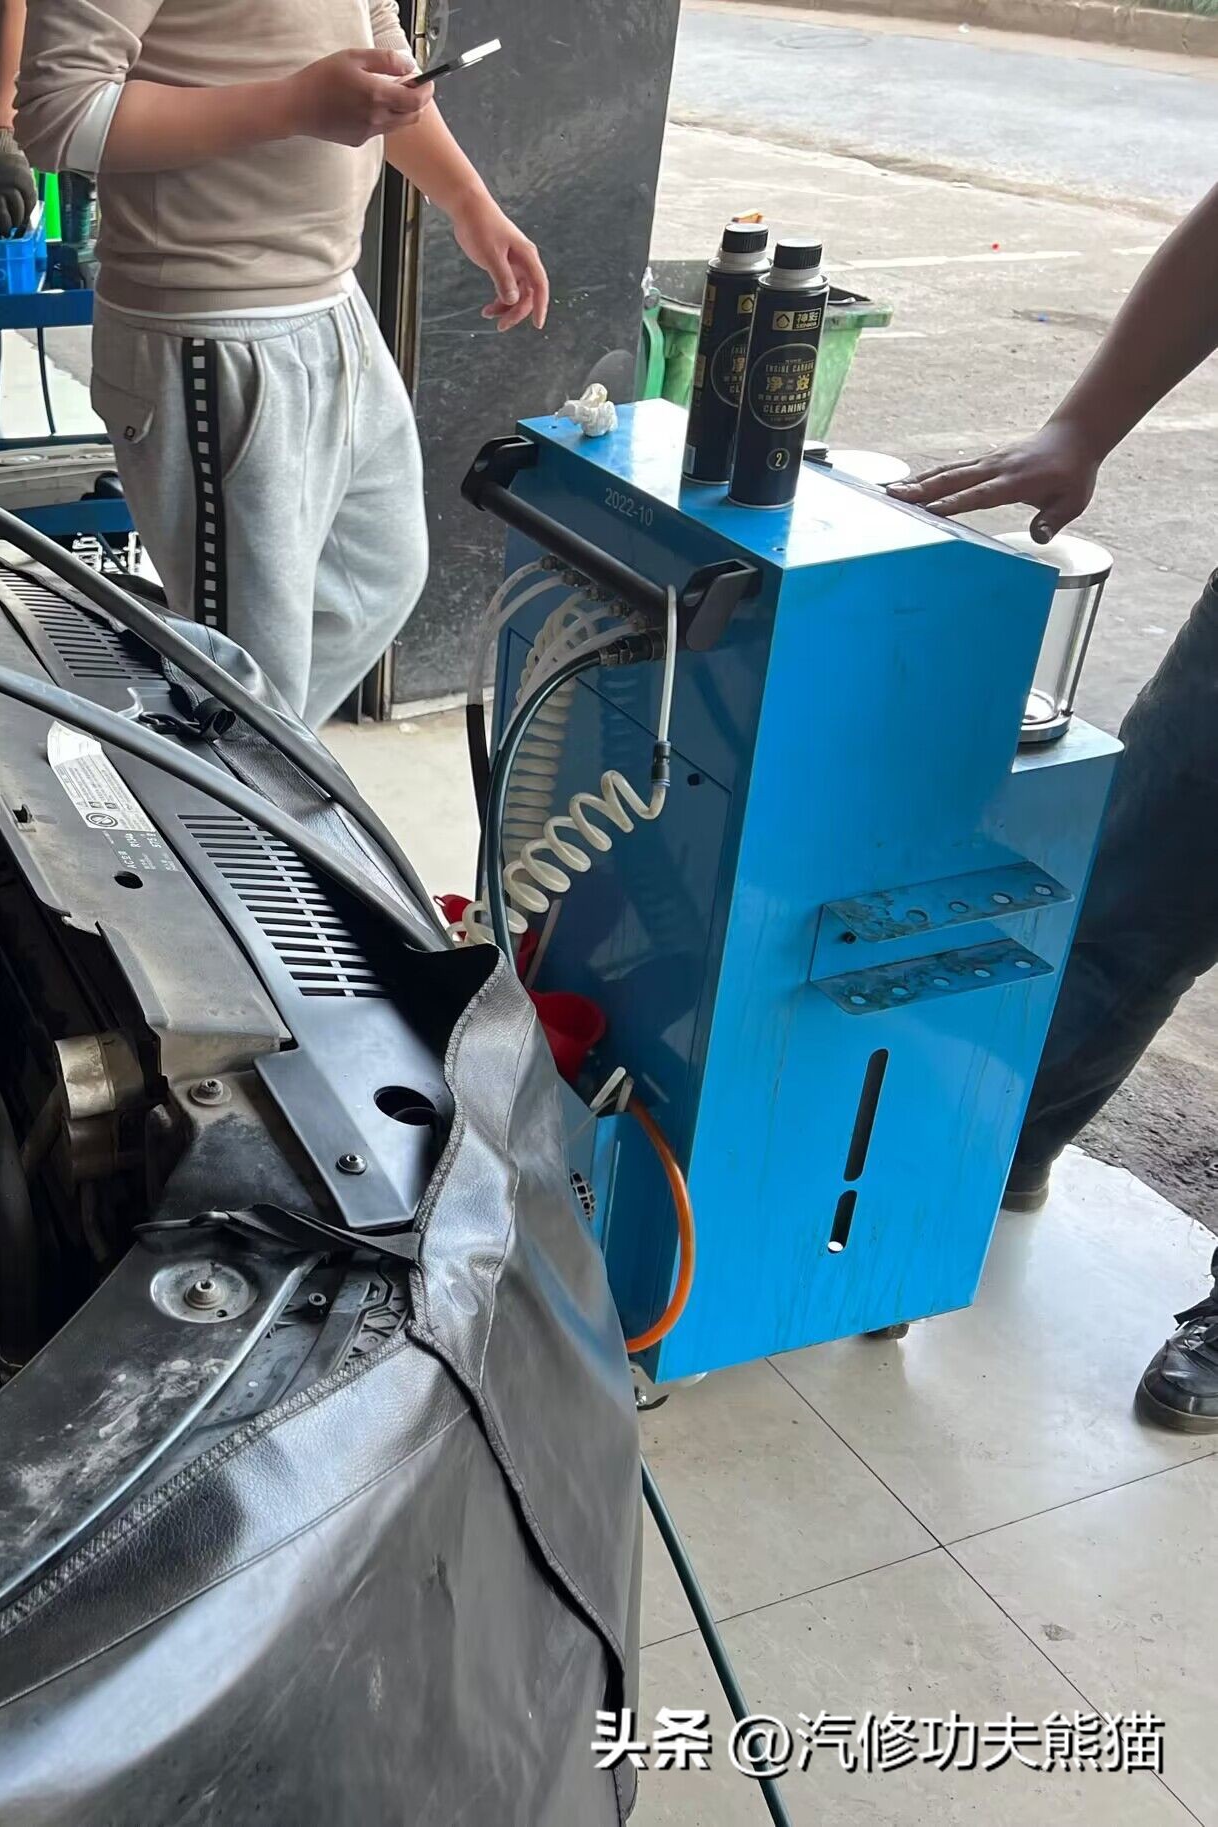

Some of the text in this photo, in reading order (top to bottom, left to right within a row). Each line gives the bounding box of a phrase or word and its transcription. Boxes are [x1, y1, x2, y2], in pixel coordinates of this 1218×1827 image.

[763, 401, 806, 414] CLEANING
[775, 452, 782, 466] 2
[605, 487, 654, 526] 2022-10
